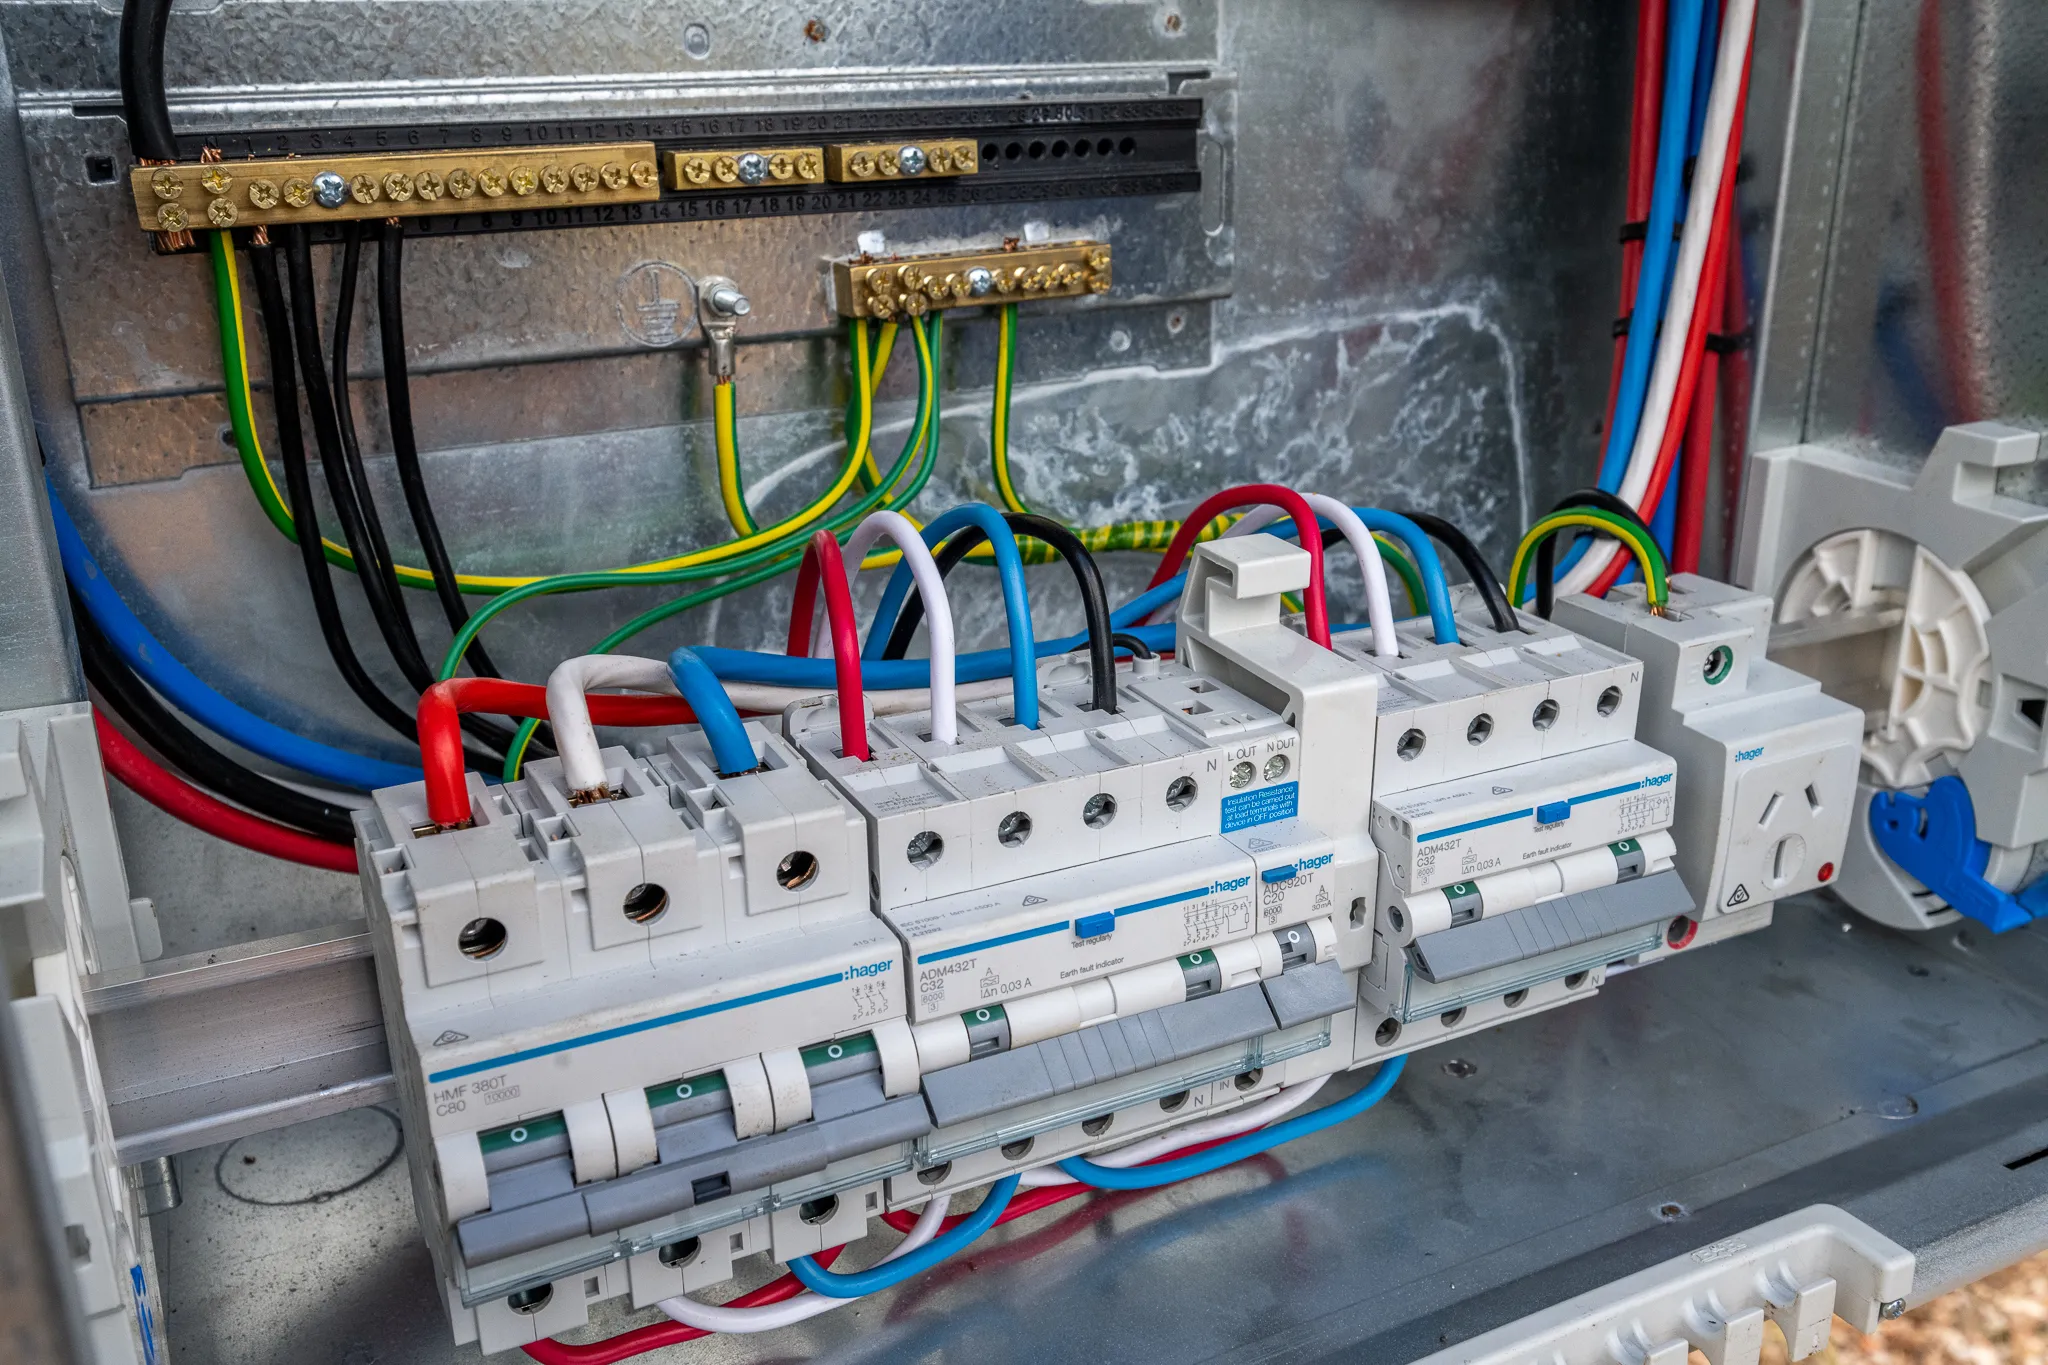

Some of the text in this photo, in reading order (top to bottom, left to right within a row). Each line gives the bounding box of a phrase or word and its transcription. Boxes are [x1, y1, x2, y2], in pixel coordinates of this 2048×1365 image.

[276, 135, 291, 151] 2
[309, 131, 322, 149] 3
[342, 130, 357, 147] 4
[376, 130, 388, 146] 5
[408, 129, 419, 146] 6
[438, 126, 449, 144] 7
[470, 125, 482, 144] 8
[501, 124, 513, 142] 9
[521, 124, 548, 142] 10
[555, 122, 577, 140] 11
[585, 121, 607, 139] 12
[614, 121, 637, 139] 13
[642, 120, 665, 138] 14
[669, 119, 691, 136] 15
[699, 118, 720, 134] 16
[728, 117, 745, 133] 17
[755, 116, 776, 132] 18
[780, 116, 801, 131] 19
[807, 115, 828, 130] 20
[833, 114, 852, 130] 21
[859, 113, 879, 129] 22
[884, 112, 904, 128] 23
[511, 211, 523, 227] 9
[534, 209, 557, 226] 10
[564, 208, 584, 224] 11
[593, 204, 615, 221] 12
[620, 203, 643, 220] 13
[650, 202, 672, 219] 14
[678, 200, 699, 218] 15
[705, 199, 726, 216] 16
[732, 199, 752, 215] 17
[760, 196, 780, 213] 18
[786, 196, 806, 211] 19
[811, 194, 832, 211] 20
[837, 192, 857, 209] 21
[862, 191, 883, 208] 22
[889, 190, 908, 207] 23
[913, 189, 931, 206] 24
[1630, 670, 1640, 684] N
[1266, 736, 1296, 753] N OUT
[1227, 745, 1257, 762] L OUT
[1206, 758, 1217, 773] N
[1224, 792, 1295, 814] test can be carried out
[1227, 786, 1294, 806] Insulation Resistance
[1224, 818, 1246, 829] device
[1253, 813, 1268, 822] OFF
[1269, 807, 1294, 820] position
[1226, 800, 1293, 822] at load terminals with
[1533, 820, 1566, 833] Test regularly
[1417, 839, 1462, 858] ADM432T
[1522, 841, 1573, 860] Earth fault indicator
[1416, 855, 1436, 868] C32
[1476, 858, 1494, 871] 0,03
[1494, 857, 1502, 867] A
[1263, 872, 1315, 897] ADC920T
[1263, 891, 1286, 905] C20
[1263, 905, 1282, 917] 6000
[1071, 933, 1113, 949] Test regularly
[920, 957, 977, 982] ADM432T
[985, 967, 993, 977] A
[1060, 956, 1125, 979] Earth fault indicator
[920, 978, 944, 993] C32
[1000, 980, 1022, 995] 0,03
[1023, 977, 1032, 988] A
[1591, 974, 1600, 986] N
[922, 991, 944, 1004] 6000
[930, 1003, 936, 1012] 3
[433, 1074, 508, 1104] HMF 380T
[1219, 1079, 1230, 1091] IN
[487, 1087, 518, 1102] 10000
[1193, 1094, 1204, 1107] N
[436, 1100, 466, 1117] C80
